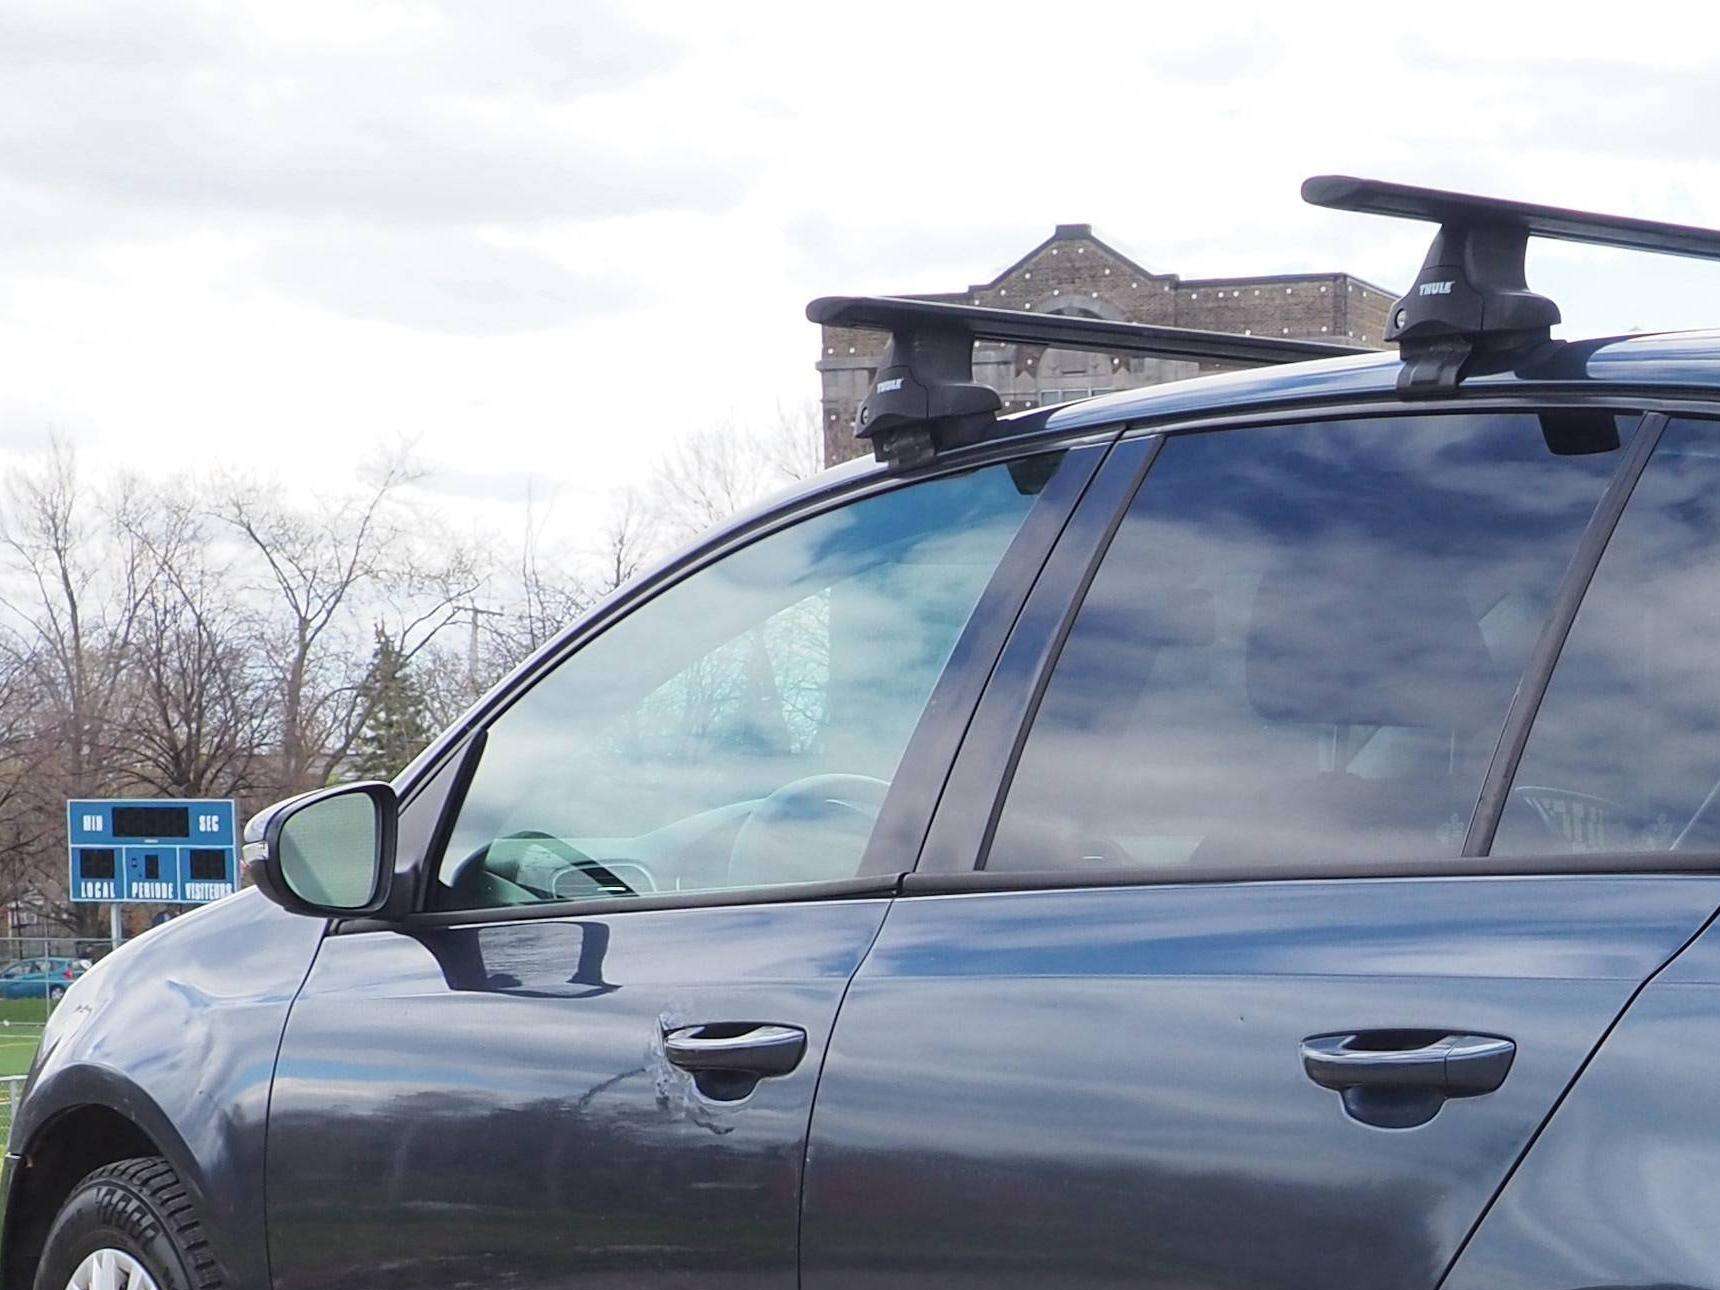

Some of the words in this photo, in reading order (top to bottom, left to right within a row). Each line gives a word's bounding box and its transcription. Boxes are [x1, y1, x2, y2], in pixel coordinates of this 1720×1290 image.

[1419, 281, 1456, 296] THULE
[199, 814, 219, 832] SEC
[81, 881, 115, 898] LOCAL
